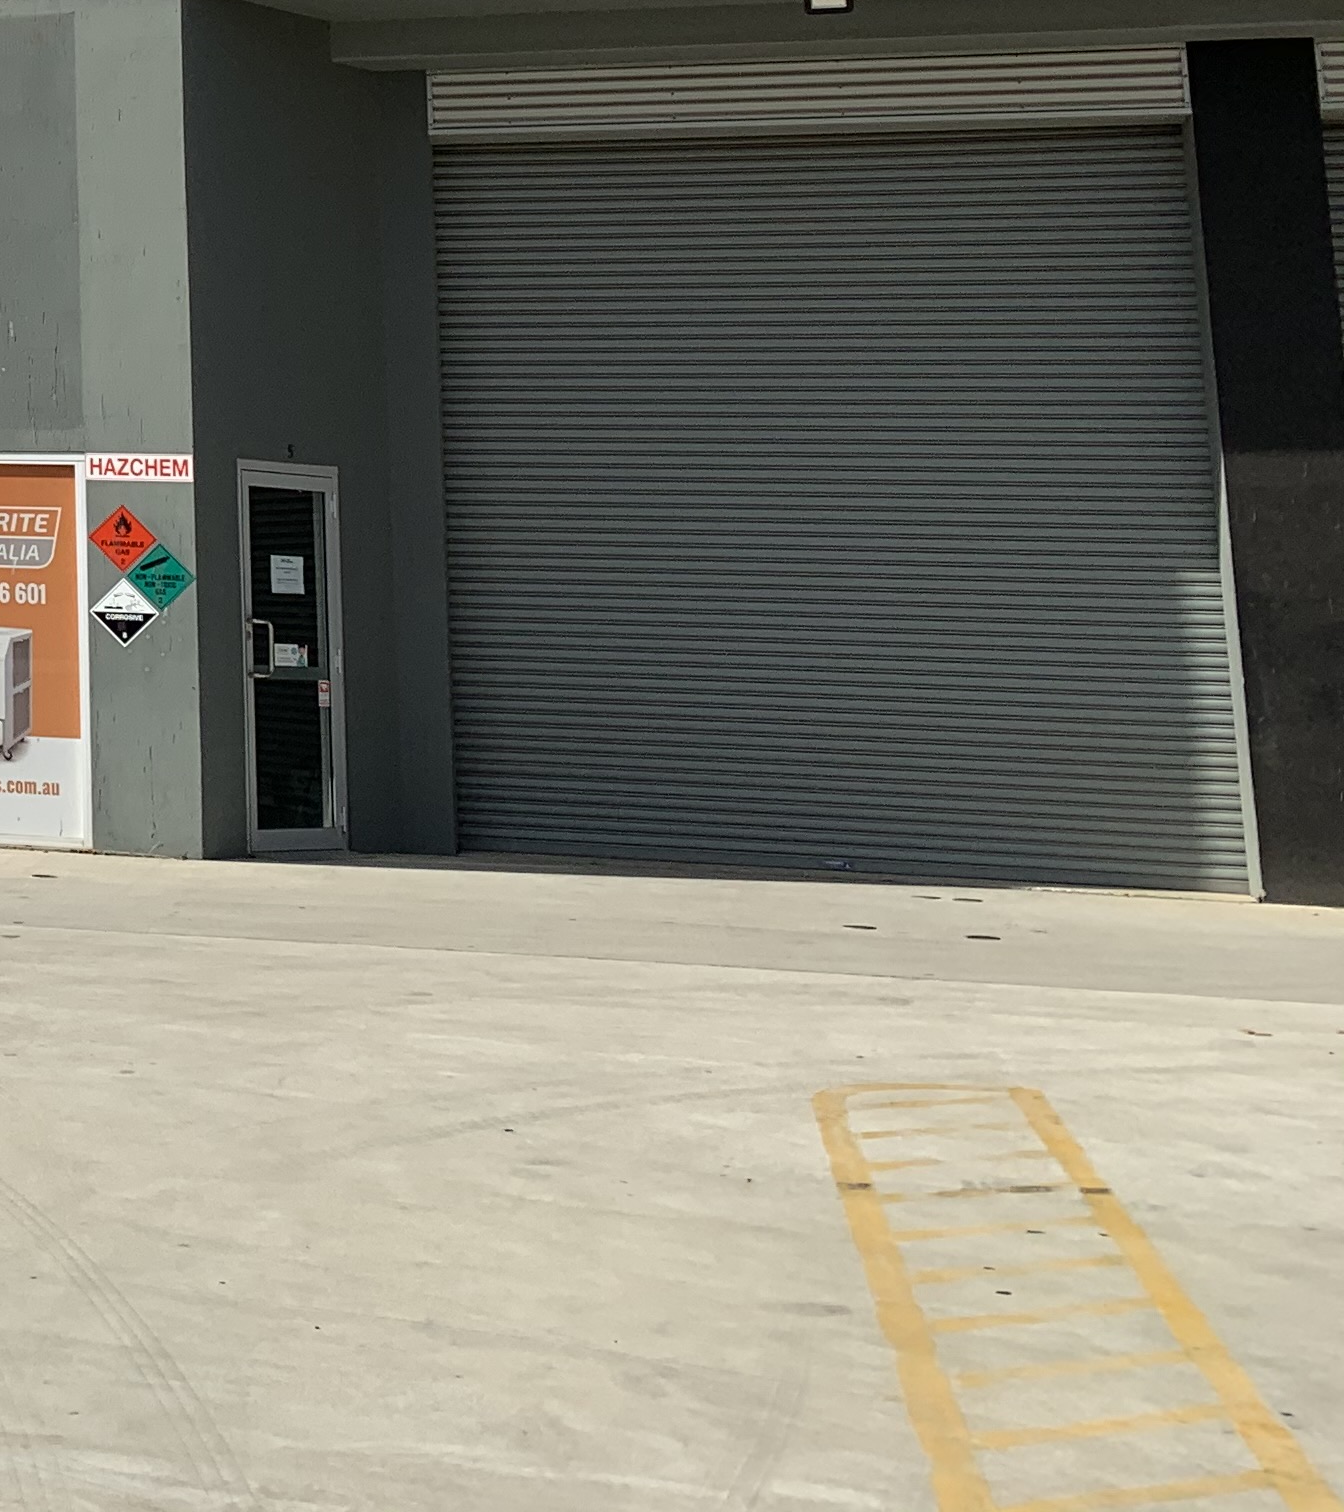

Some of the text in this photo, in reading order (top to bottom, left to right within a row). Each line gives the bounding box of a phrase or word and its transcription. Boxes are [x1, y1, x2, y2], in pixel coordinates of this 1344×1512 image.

[89, 457, 189, 477] HAZCHEM
[14, 583, 47, 605] 601
[105, 613, 144, 622] CORROSIVE
